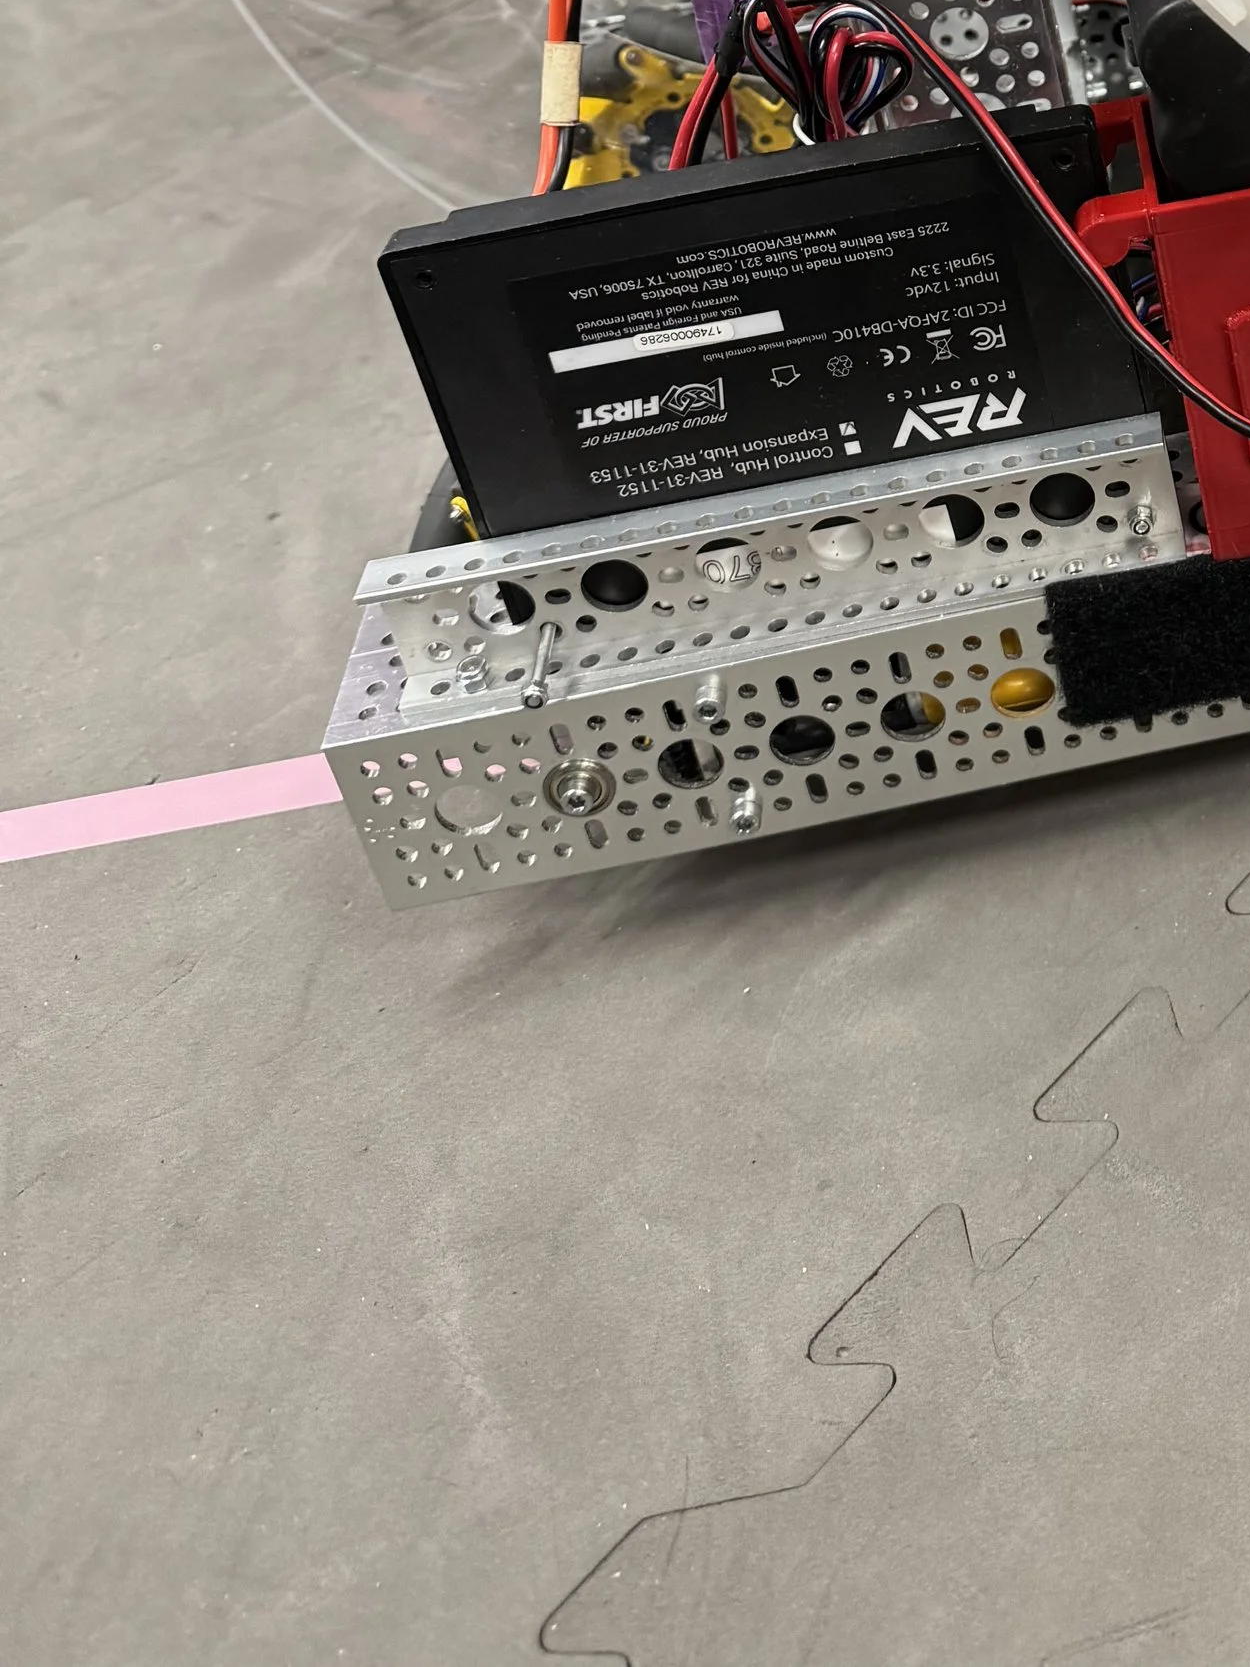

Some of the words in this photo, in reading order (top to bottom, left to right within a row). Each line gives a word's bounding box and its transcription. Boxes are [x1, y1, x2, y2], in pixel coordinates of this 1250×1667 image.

[886, 227, 915, 240] East
[917, 222, 950, 235] 2225
[676, 227, 837, 266] www.REVROBOTICS.com
[840, 233, 884, 250] Beltine
[764, 248, 798, 263] Suite
[801, 242, 837, 258] Road,
[844, 247, 894, 263] Custom
[735, 256, 762, 270] 321,
[791, 260, 804, 273] in
[806, 255, 842, 271] made
[910, 262, 941, 278] 3.3v
[944, 253, 996, 272] Signal:
[666, 260, 733, 282] Carrollton,
[752, 265, 789, 282] China
[600, 278, 644, 294] 75006,
[646, 274, 665, 287] TX
[702, 277, 729, 290] REV
[730, 274, 750, 286] for
[954, 270, 1000, 289] Input:
[569, 286, 599, 301] USA
[641, 283, 698, 302] Robotics
[905, 279, 951, 299] 12vdc
[665, 304, 690, 316] void
[691, 294, 739, 312] warranty
[977, 300, 1007, 316] FCC
[626, 309, 655, 323] label
[655, 307, 664, 318] if
[700, 310, 718, 322] and
[720, 306, 742, 318] USA
[953, 306, 974, 320] ID:
[576, 314, 625, 332] removed
[623, 320, 660, 335] Patents
[662, 313, 699, 329] Foreign
[832, 310, 950, 343] 2AFQA-DB410C
[581, 325, 622, 342] Pending
[640, 325, 723, 346] 17490006286
[786, 332, 828, 348] (included
[725, 344, 757, 358] control
[757, 339, 785, 352] inside
[702, 349, 724, 363] hub)
[887, 370, 1016, 402] ROBOTICS
[682, 412, 728, 430] PROUD
[892, 387, 1027, 449] REV
[603, 421, 680, 444] SUPPORTER
[742, 427, 829, 452] Expansion
[580, 435, 600, 448] OF
[699, 442, 739, 462] Hub,
[773, 445, 834, 468] Control
[590, 453, 697, 484] REV-31-1153
[730, 456, 770, 475] Hub,
[617, 466, 724, 497] REV-31-1152
